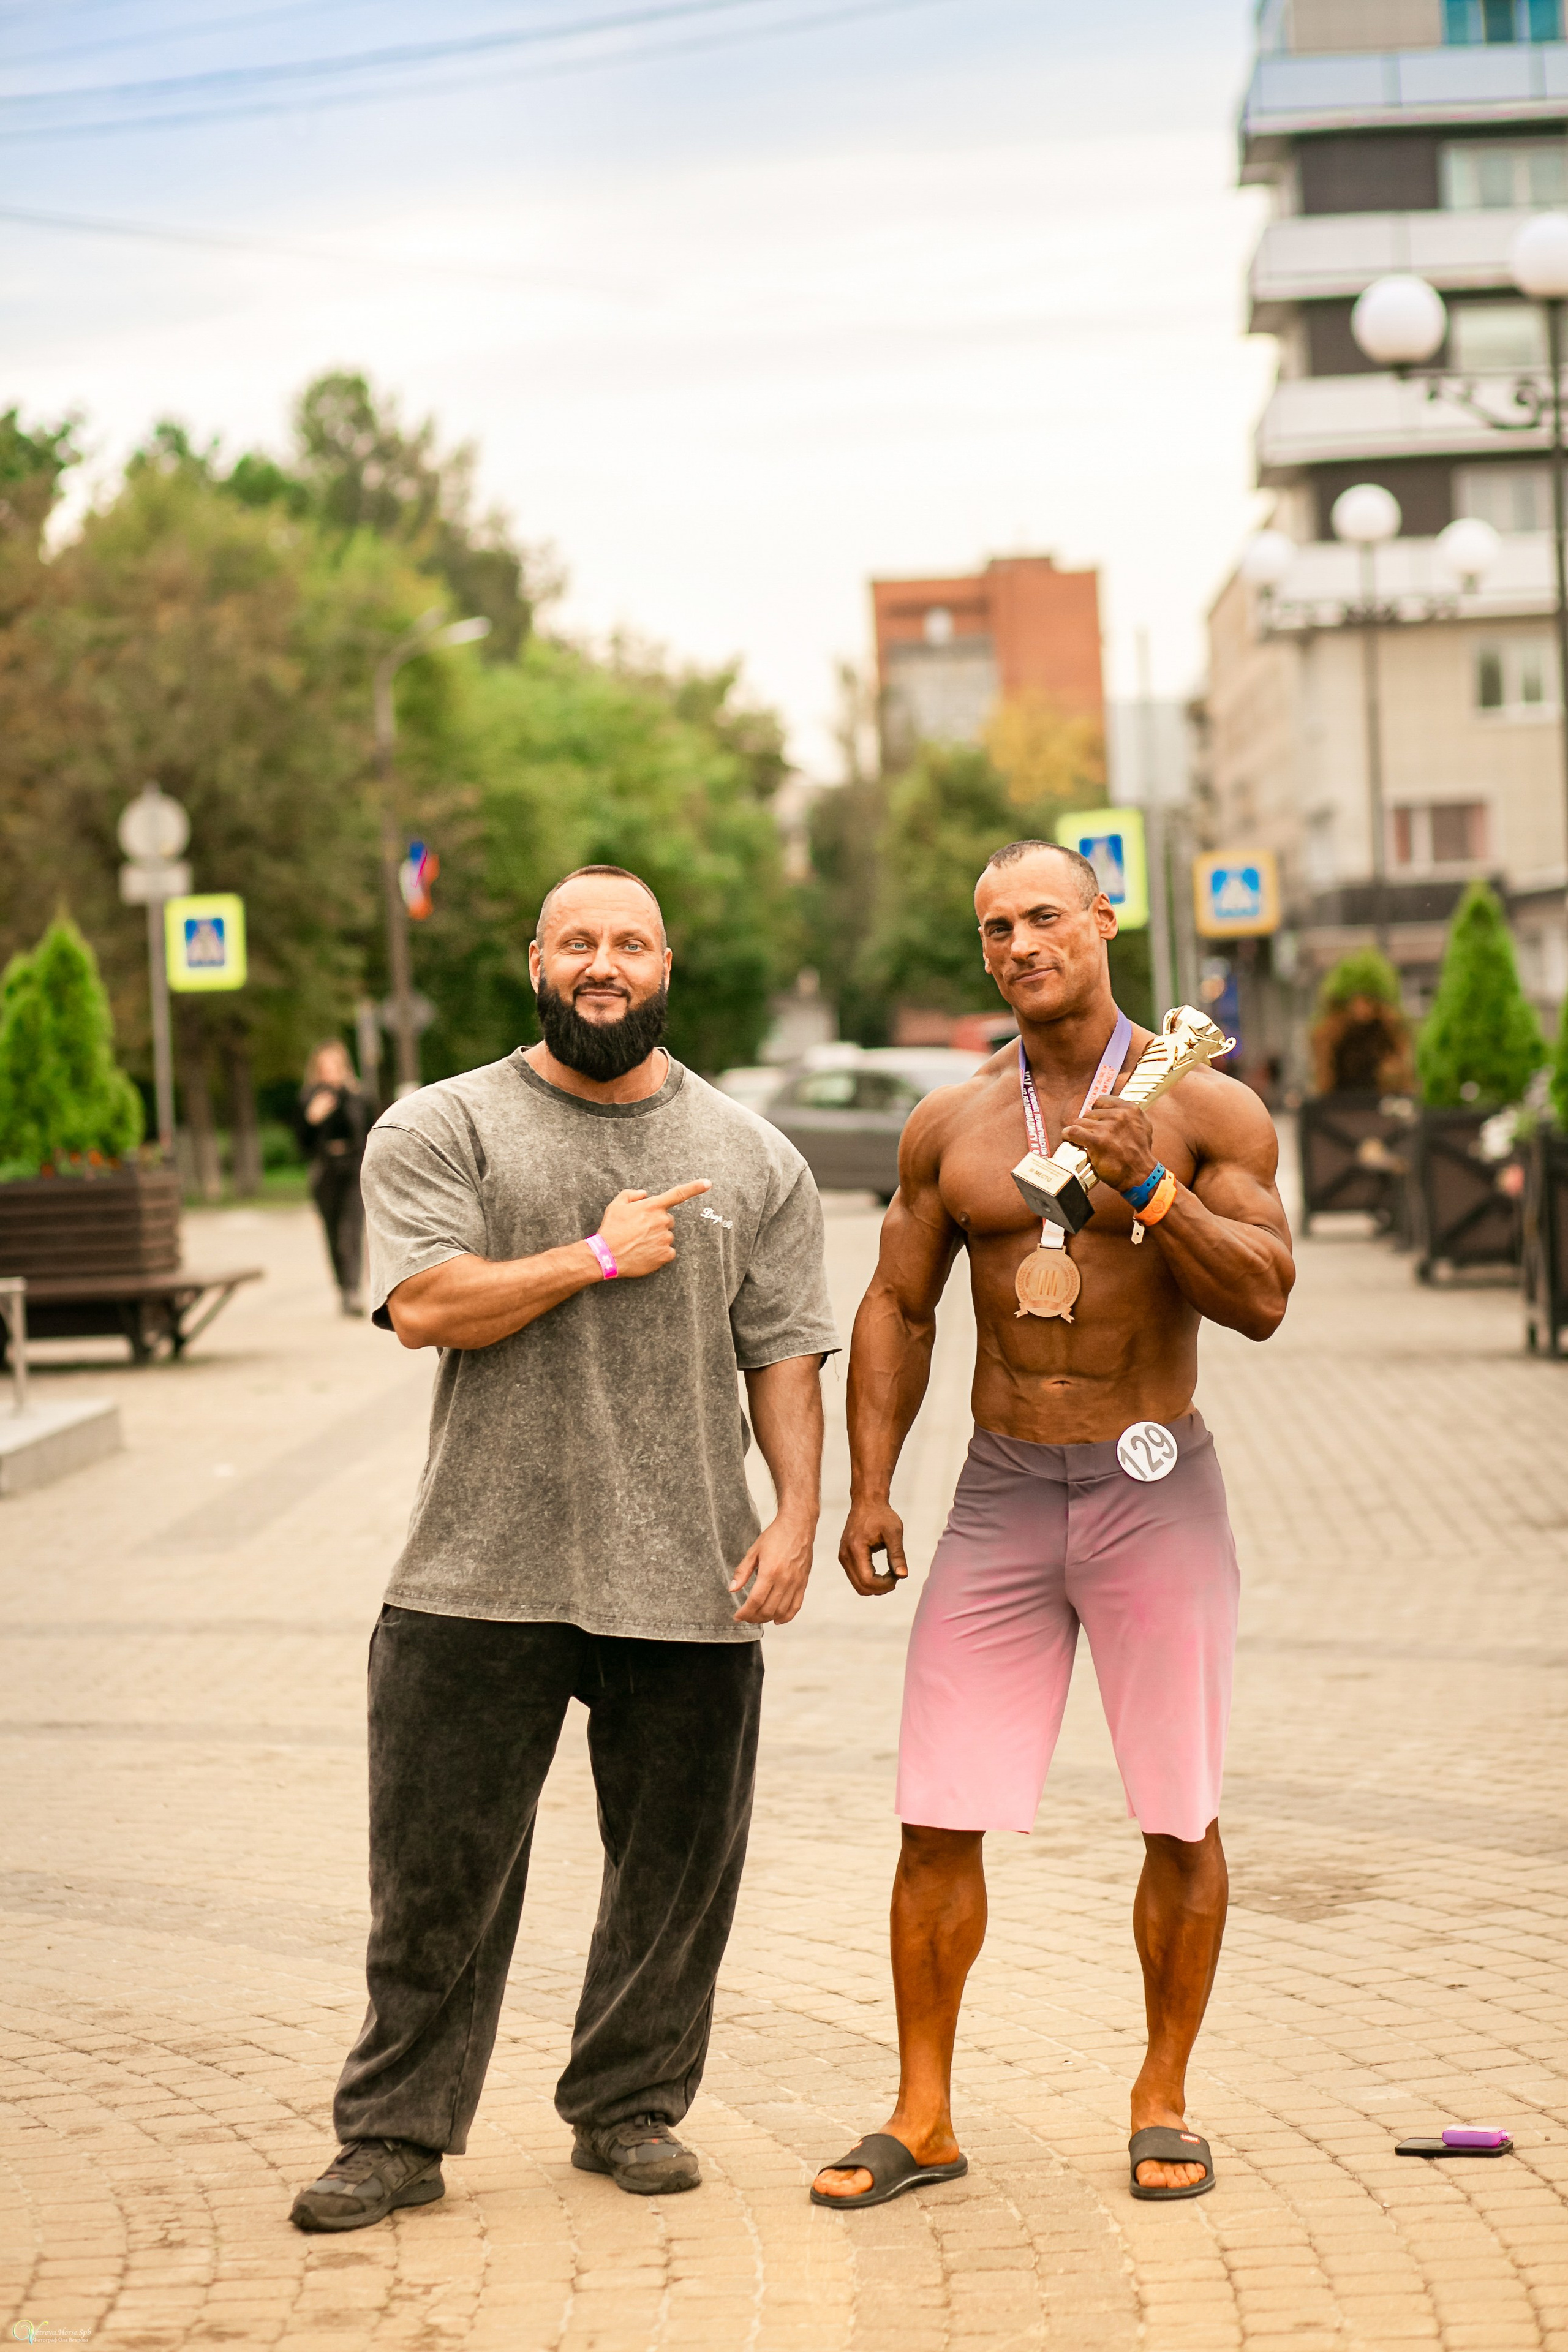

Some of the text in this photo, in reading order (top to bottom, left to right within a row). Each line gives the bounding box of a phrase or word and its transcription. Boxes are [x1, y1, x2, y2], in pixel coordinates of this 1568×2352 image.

[1101, 1068, 1115, 1093] ФИТНЕСУ
[1027, 1087, 1040, 1112] ЧЕМПИОНАТ
[1023, 1096, 1038, 1142] БОДИБИЛДИНГУ
[1033, 1114, 1048, 1155] ЛЕНИНГРАДСКОЙ
[1034, 1170, 1052, 1182] МЕСТО
[1118, 1425, 1175, 1480] 129
